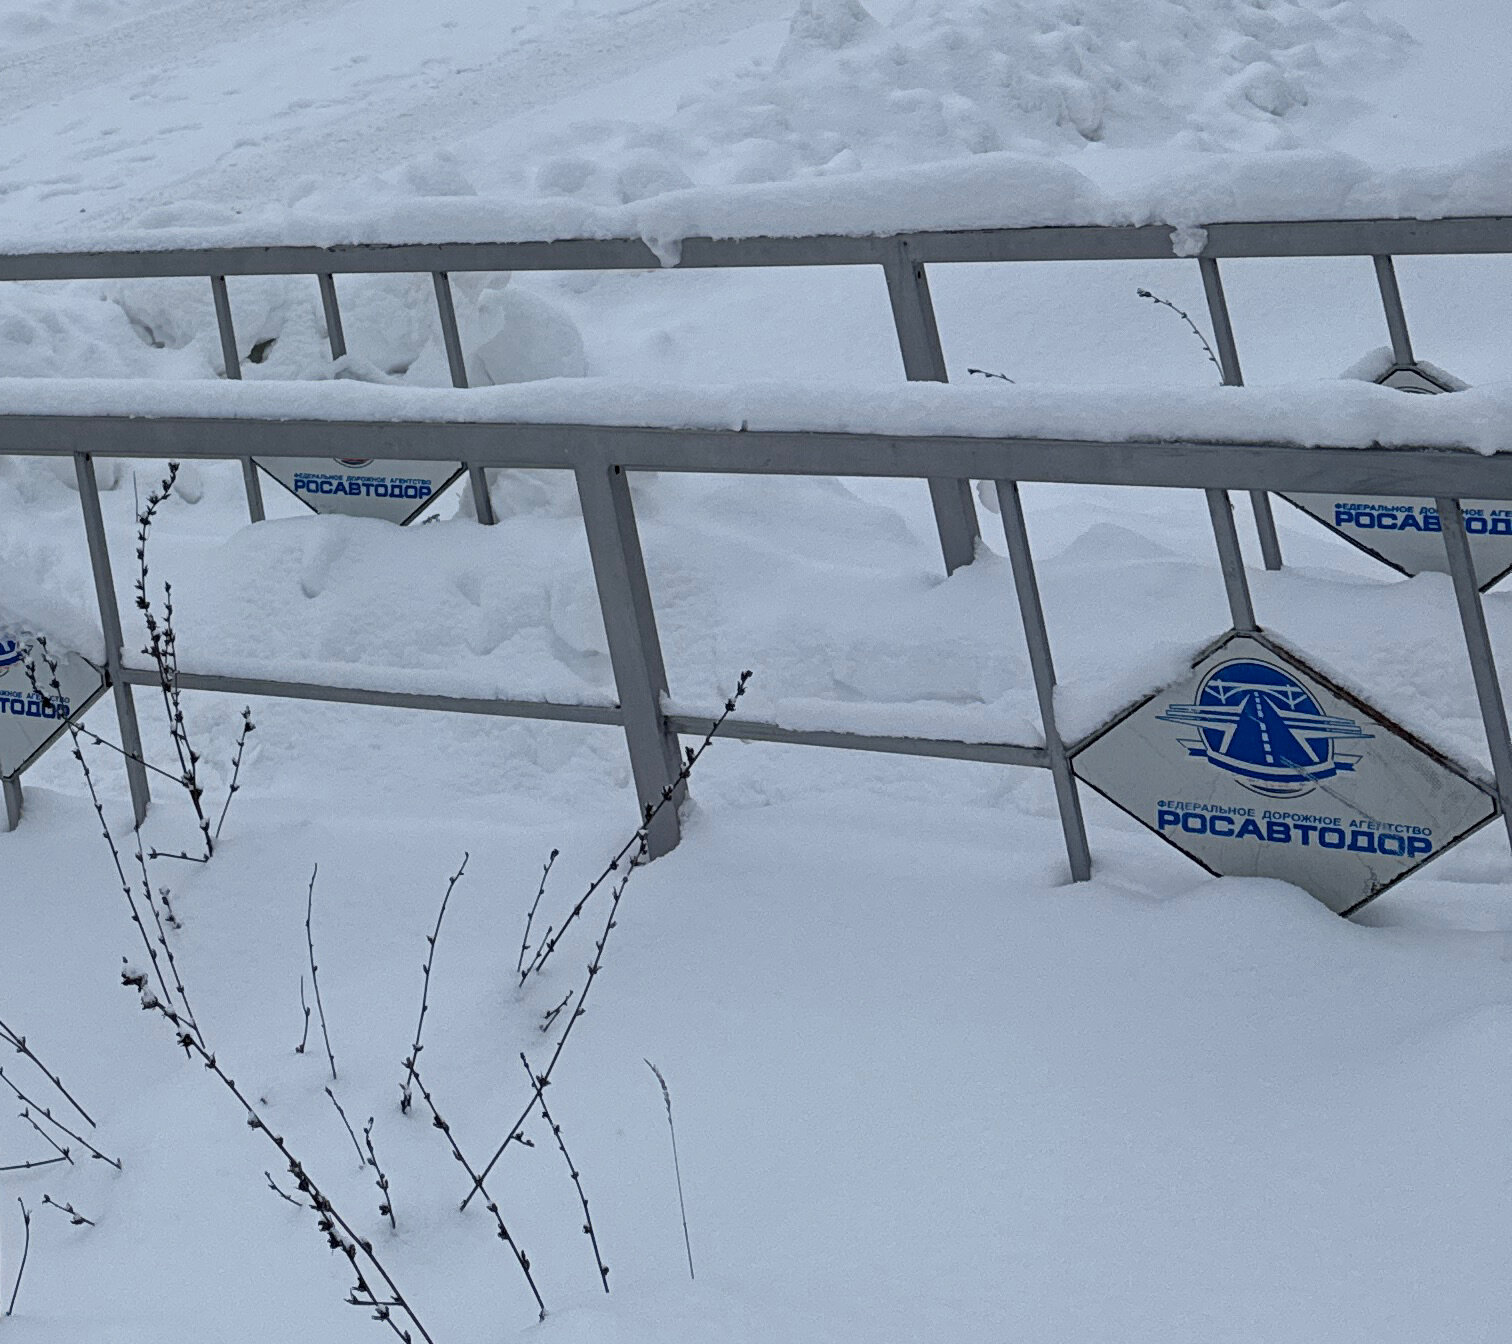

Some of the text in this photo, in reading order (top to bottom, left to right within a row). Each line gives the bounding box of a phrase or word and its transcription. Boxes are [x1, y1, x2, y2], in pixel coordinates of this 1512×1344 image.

[293, 478, 432, 499] РОСАВТОДОР
[294, 472, 432, 486] ФЕДЕРАЛЬНОЕ ДОРОЖНОЕ АГЕНТСТВО
[1334, 502, 1414, 514] ФЕДЕРАЛЬНОЕ
[1419, 506, 1484, 517] ДОНОЕ
[1334, 510, 1512, 536] РОСАВОД
[1157, 799, 1256, 817] ФЕДЕРАЛЬНОЕ
[1261, 810, 1342, 827] ДОРОЖНОЕ
[1157, 808, 1433, 859] РОСАВТОДОР
